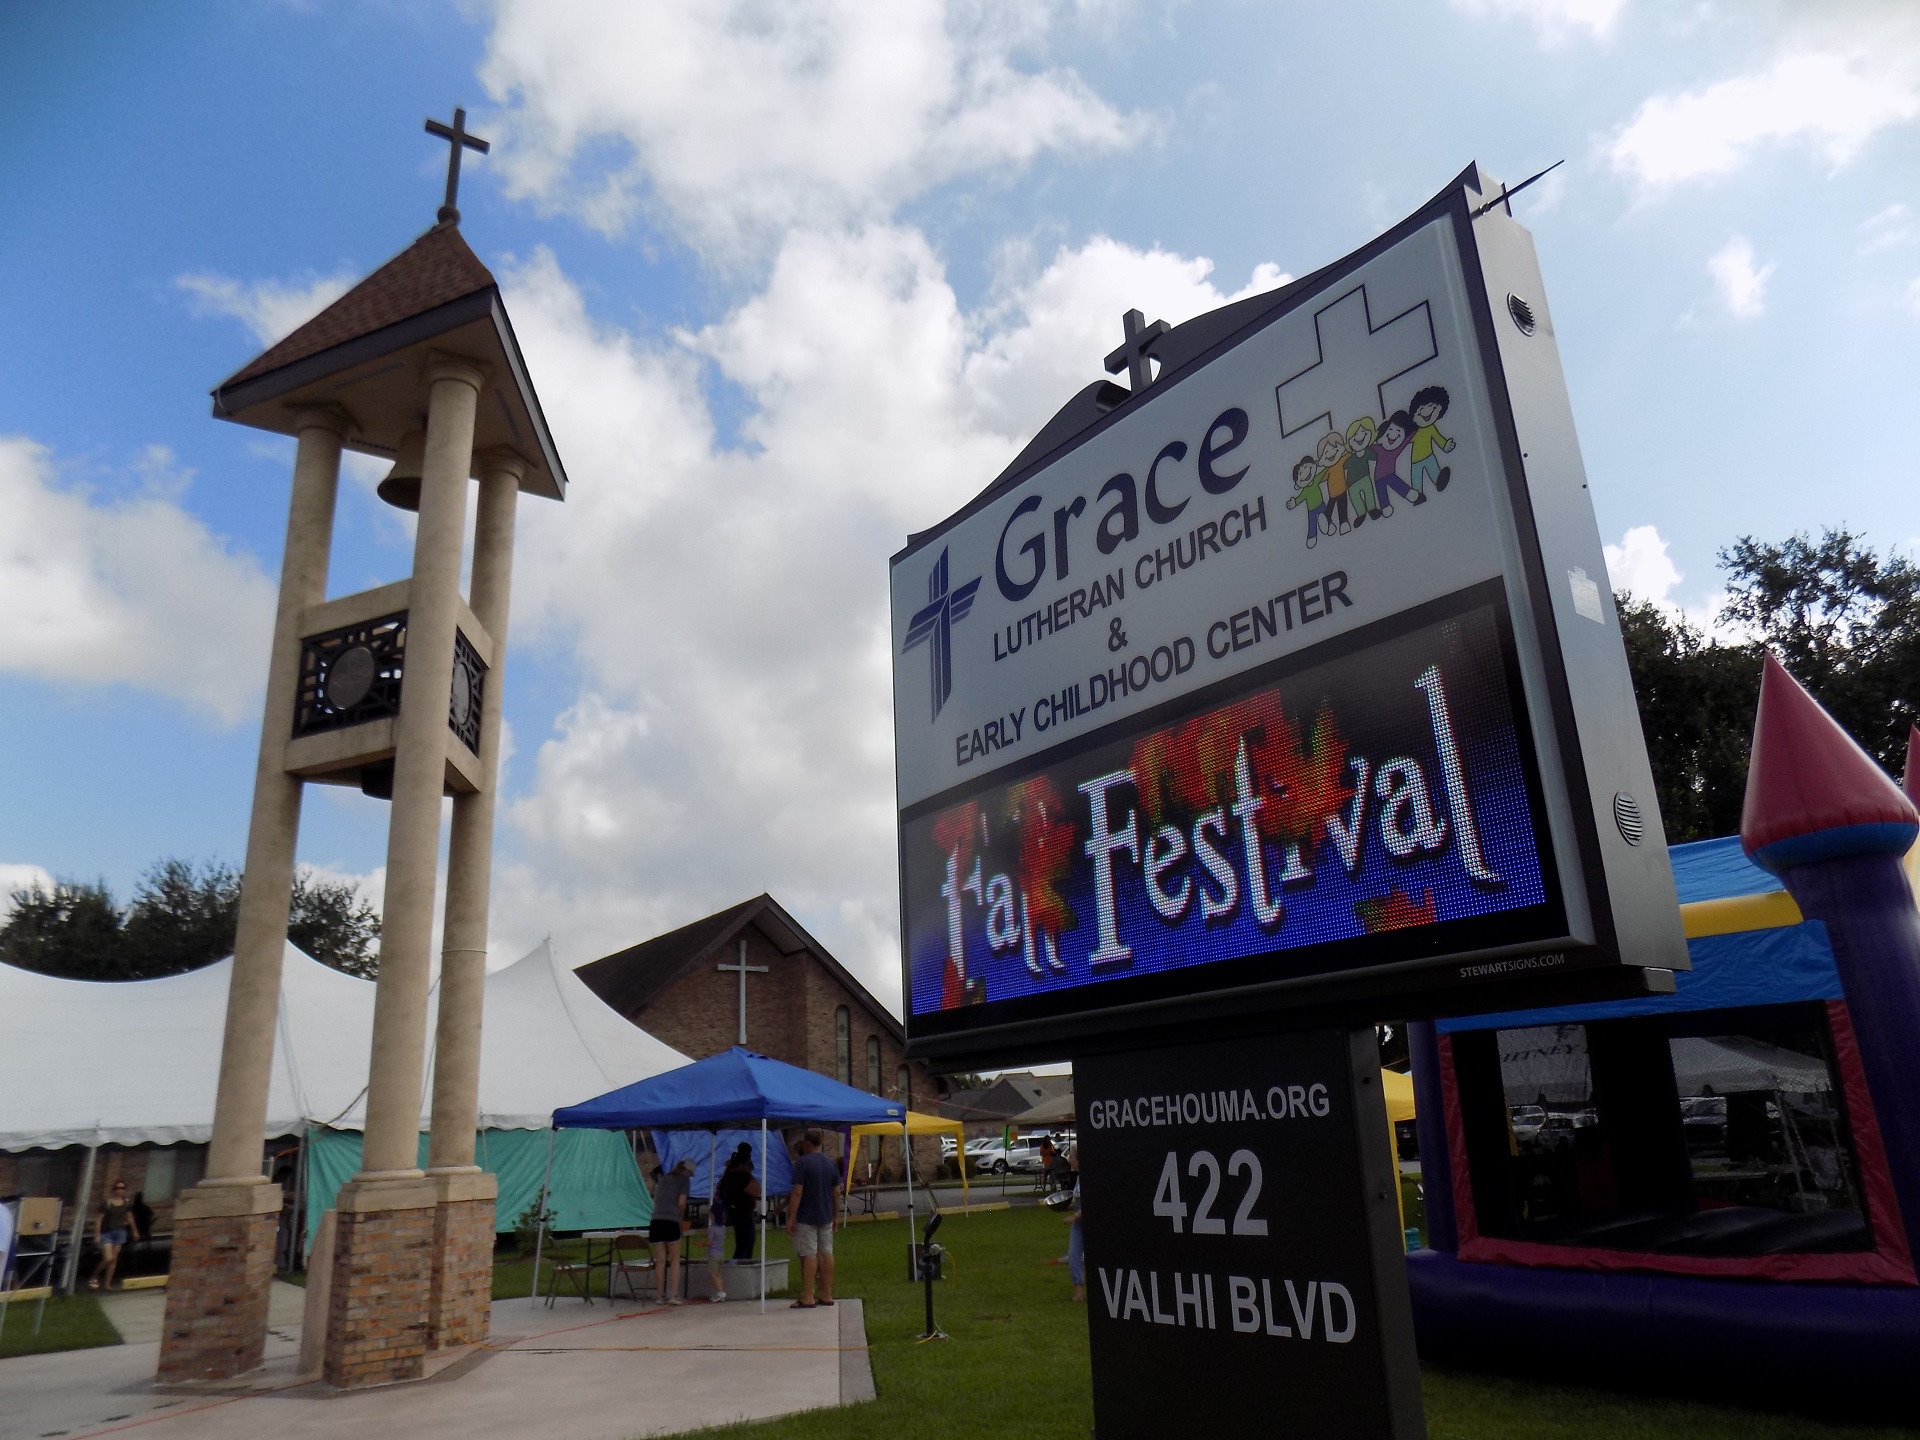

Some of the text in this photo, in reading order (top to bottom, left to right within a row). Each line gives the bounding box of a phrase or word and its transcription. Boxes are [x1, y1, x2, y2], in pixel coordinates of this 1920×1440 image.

[994, 407, 1251, 601] Grace
[993, 496, 1268, 662] LUTHERAN CHURCH
[955, 570, 1354, 767] EARLY CHILDHOOD CENTER
[1107, 617, 1129, 652] &
[1459, 953, 1565, 978] STEWARTSIGNS.COM
[1089, 1083, 1330, 1130] GRACEHOUMA.ORG
[1152, 1149, 1269, 1236] 422
[1098, 1267, 1357, 1344] VALHI BLVD
